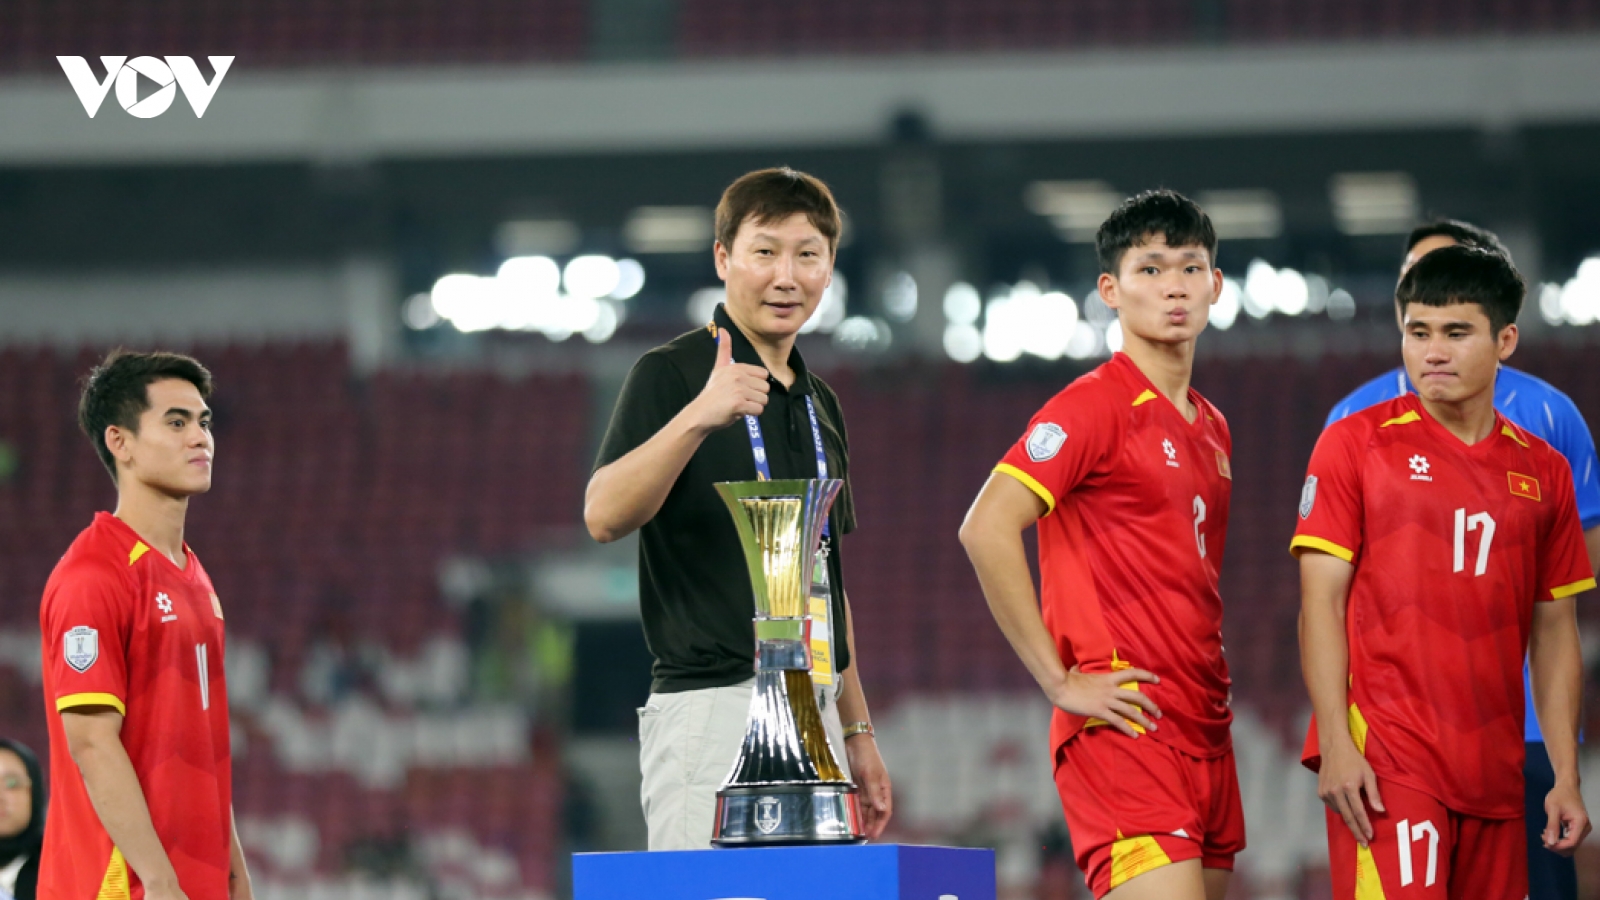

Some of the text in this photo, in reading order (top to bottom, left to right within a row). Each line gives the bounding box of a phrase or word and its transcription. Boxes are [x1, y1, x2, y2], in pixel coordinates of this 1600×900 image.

[1193, 495, 1207, 559] 2
[1453, 507, 1496, 577] 17
[195, 642, 209, 711] 11
[1396, 818, 1440, 888] 17
